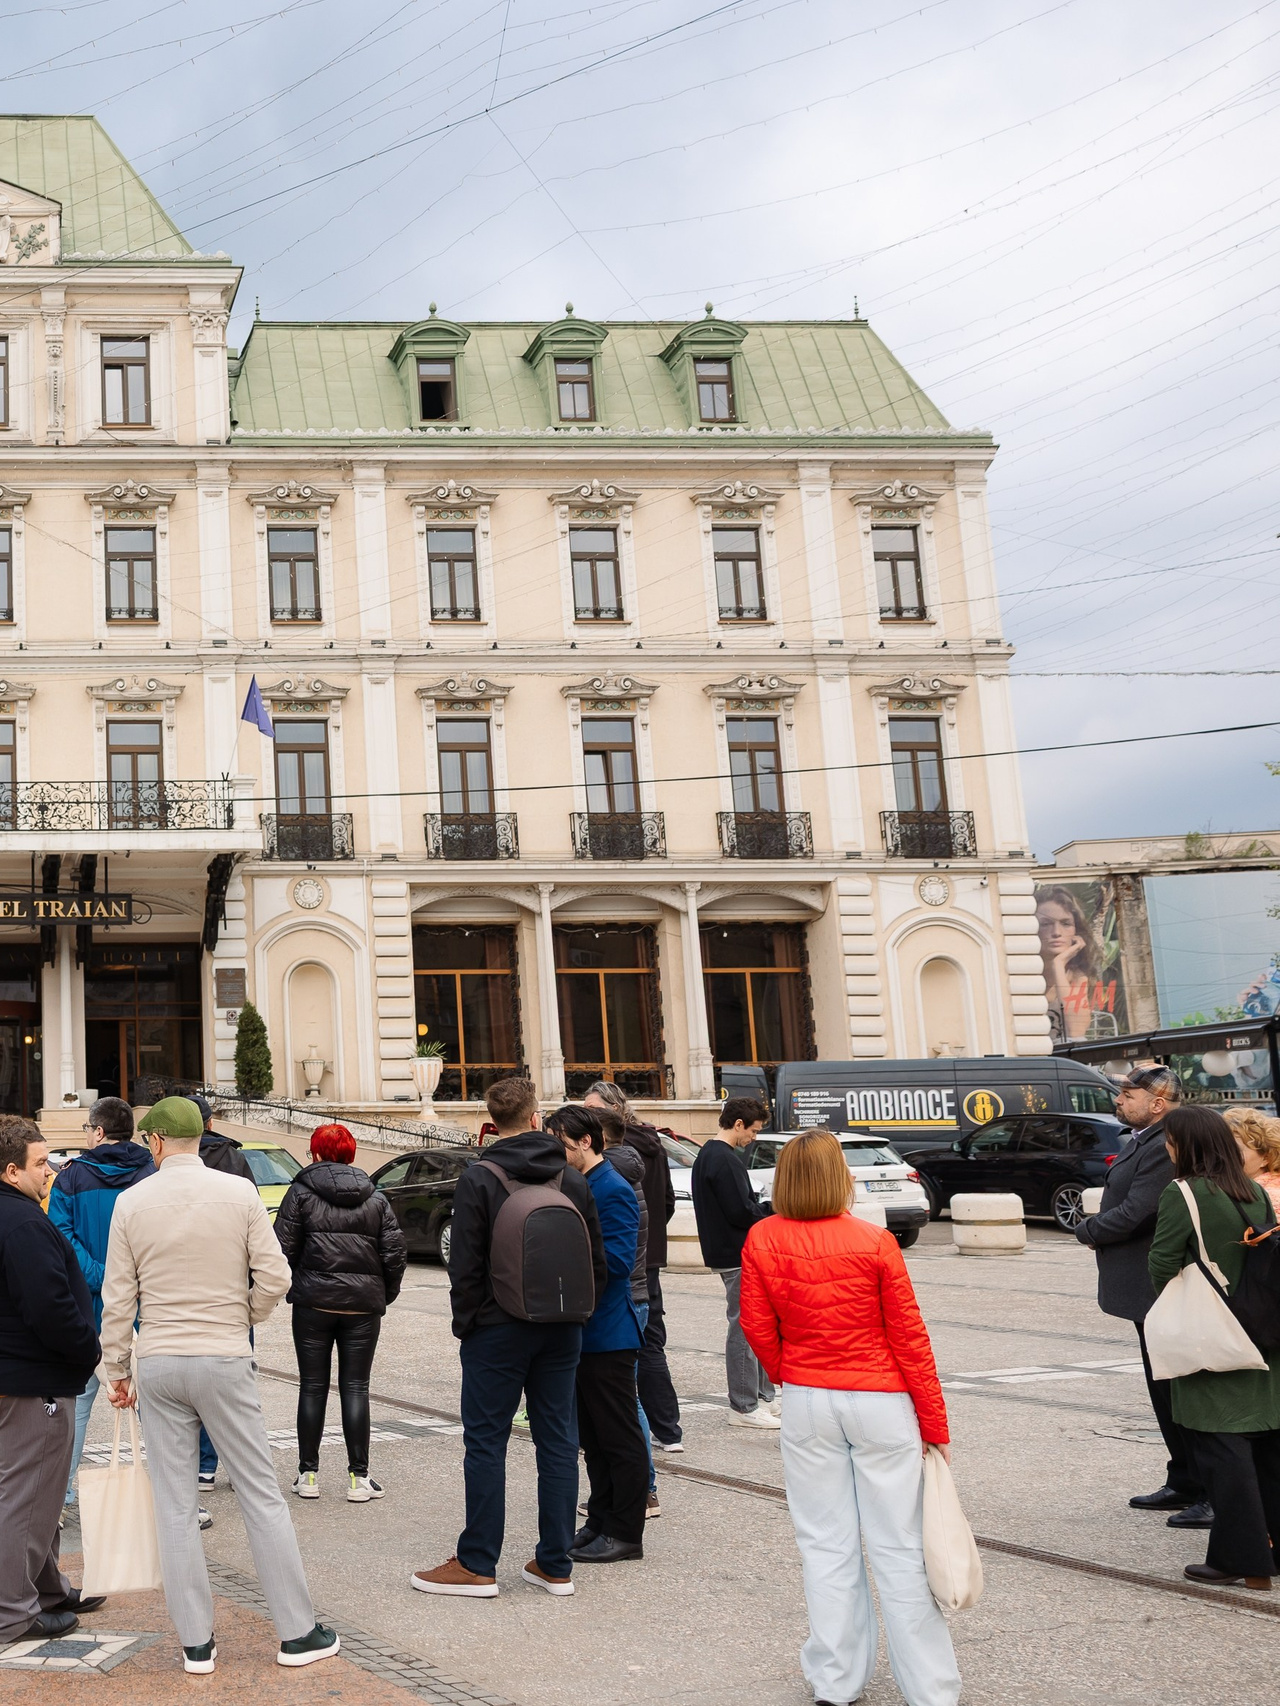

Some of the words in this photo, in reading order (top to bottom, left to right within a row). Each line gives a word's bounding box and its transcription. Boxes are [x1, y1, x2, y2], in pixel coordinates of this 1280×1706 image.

[33, 900, 127, 918] TRAIAN
[1063, 980, 1117, 1015] H&M
[846, 1089, 957, 1120] AMBIANCE
